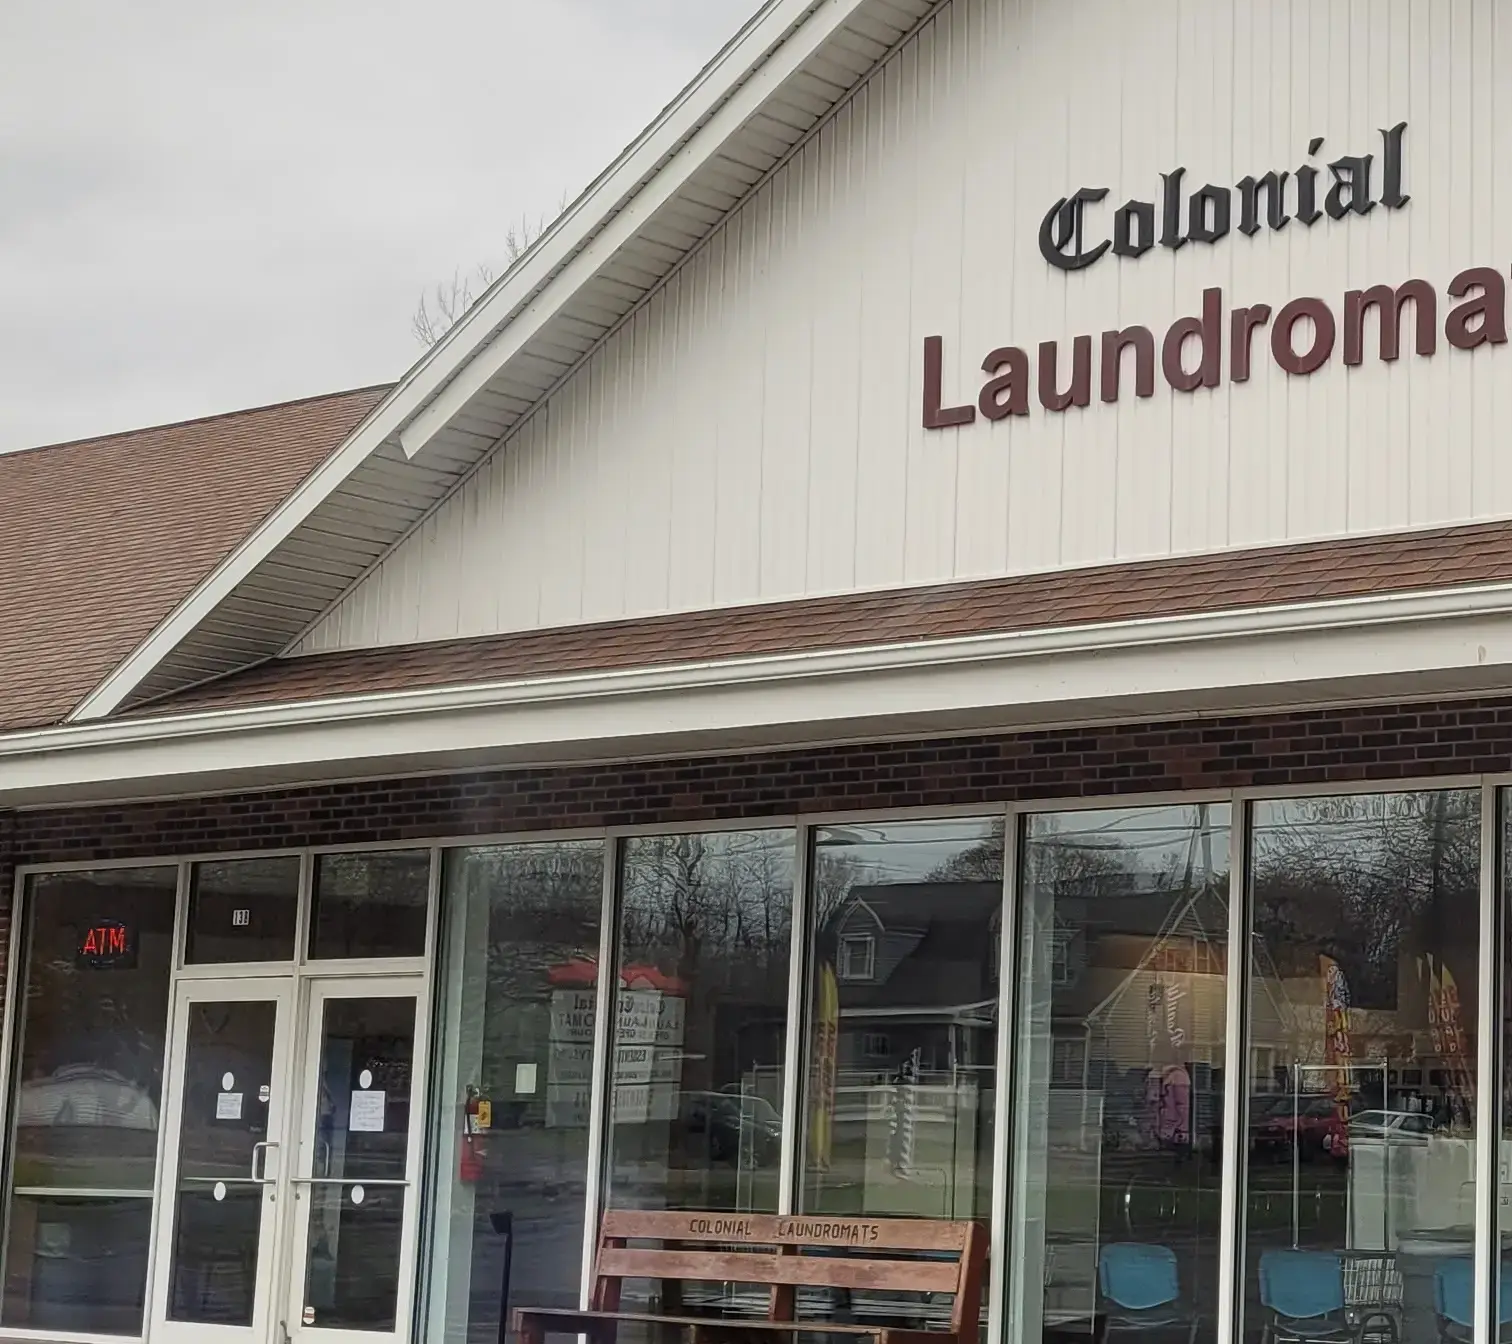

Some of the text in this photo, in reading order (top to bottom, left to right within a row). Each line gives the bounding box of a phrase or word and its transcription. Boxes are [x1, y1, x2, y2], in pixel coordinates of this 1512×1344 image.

[1038, 121, 1410, 270] Colonial
[82, 927, 126, 955] ATM
[690, 1218, 880, 1243] COLONIAL LAUNDROMATS
